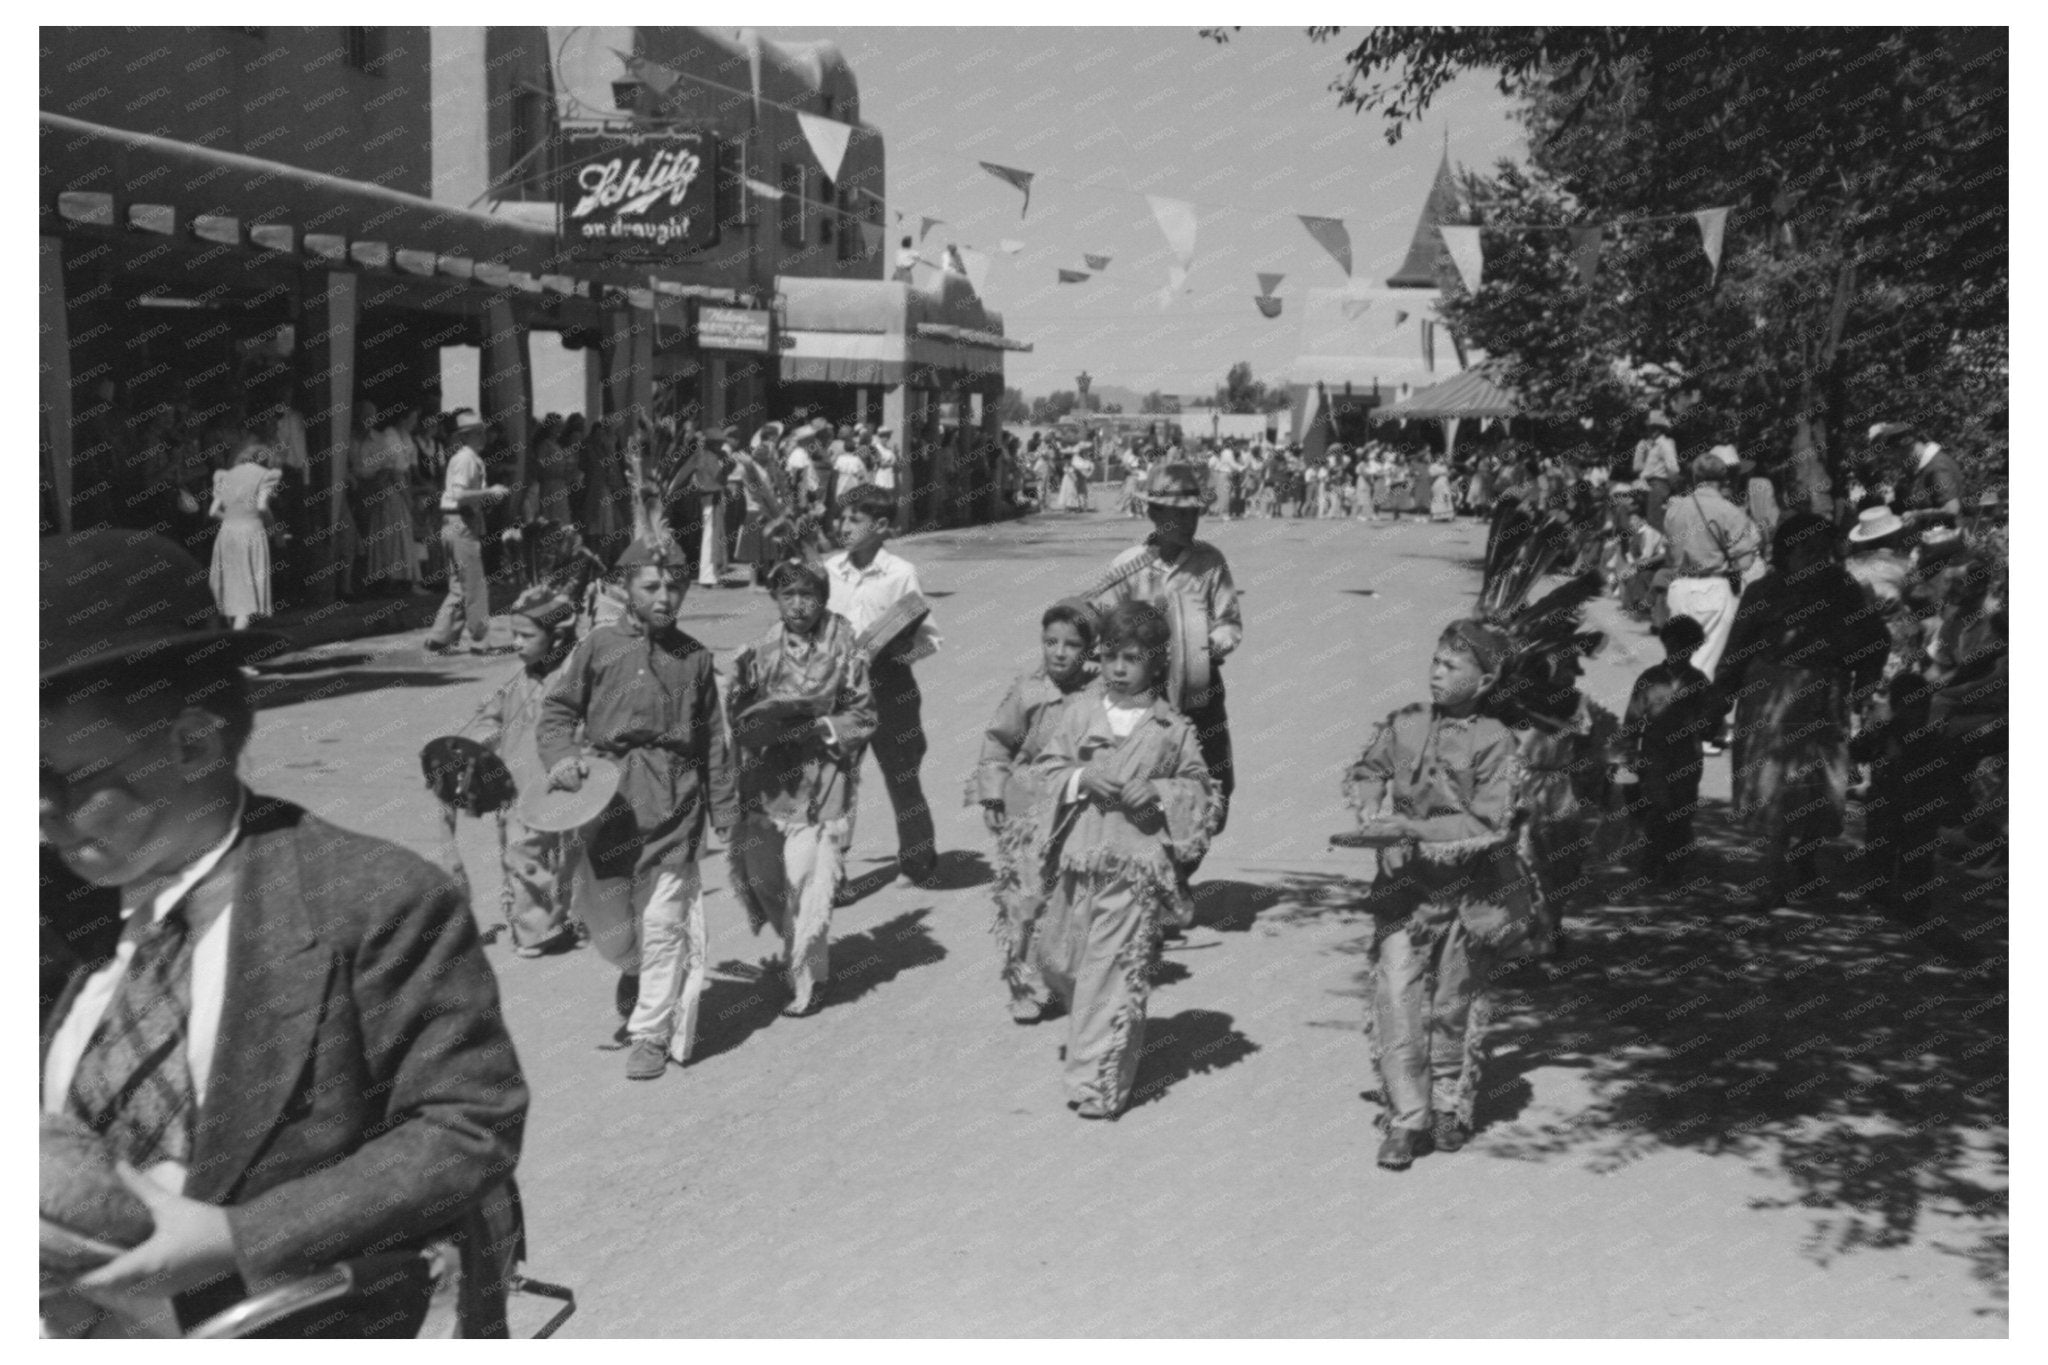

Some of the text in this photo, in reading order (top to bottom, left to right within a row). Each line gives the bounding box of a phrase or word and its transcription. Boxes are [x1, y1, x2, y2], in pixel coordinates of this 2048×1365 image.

[571, 149, 701, 217] Schlitz
[582, 216, 691, 245] on draught
